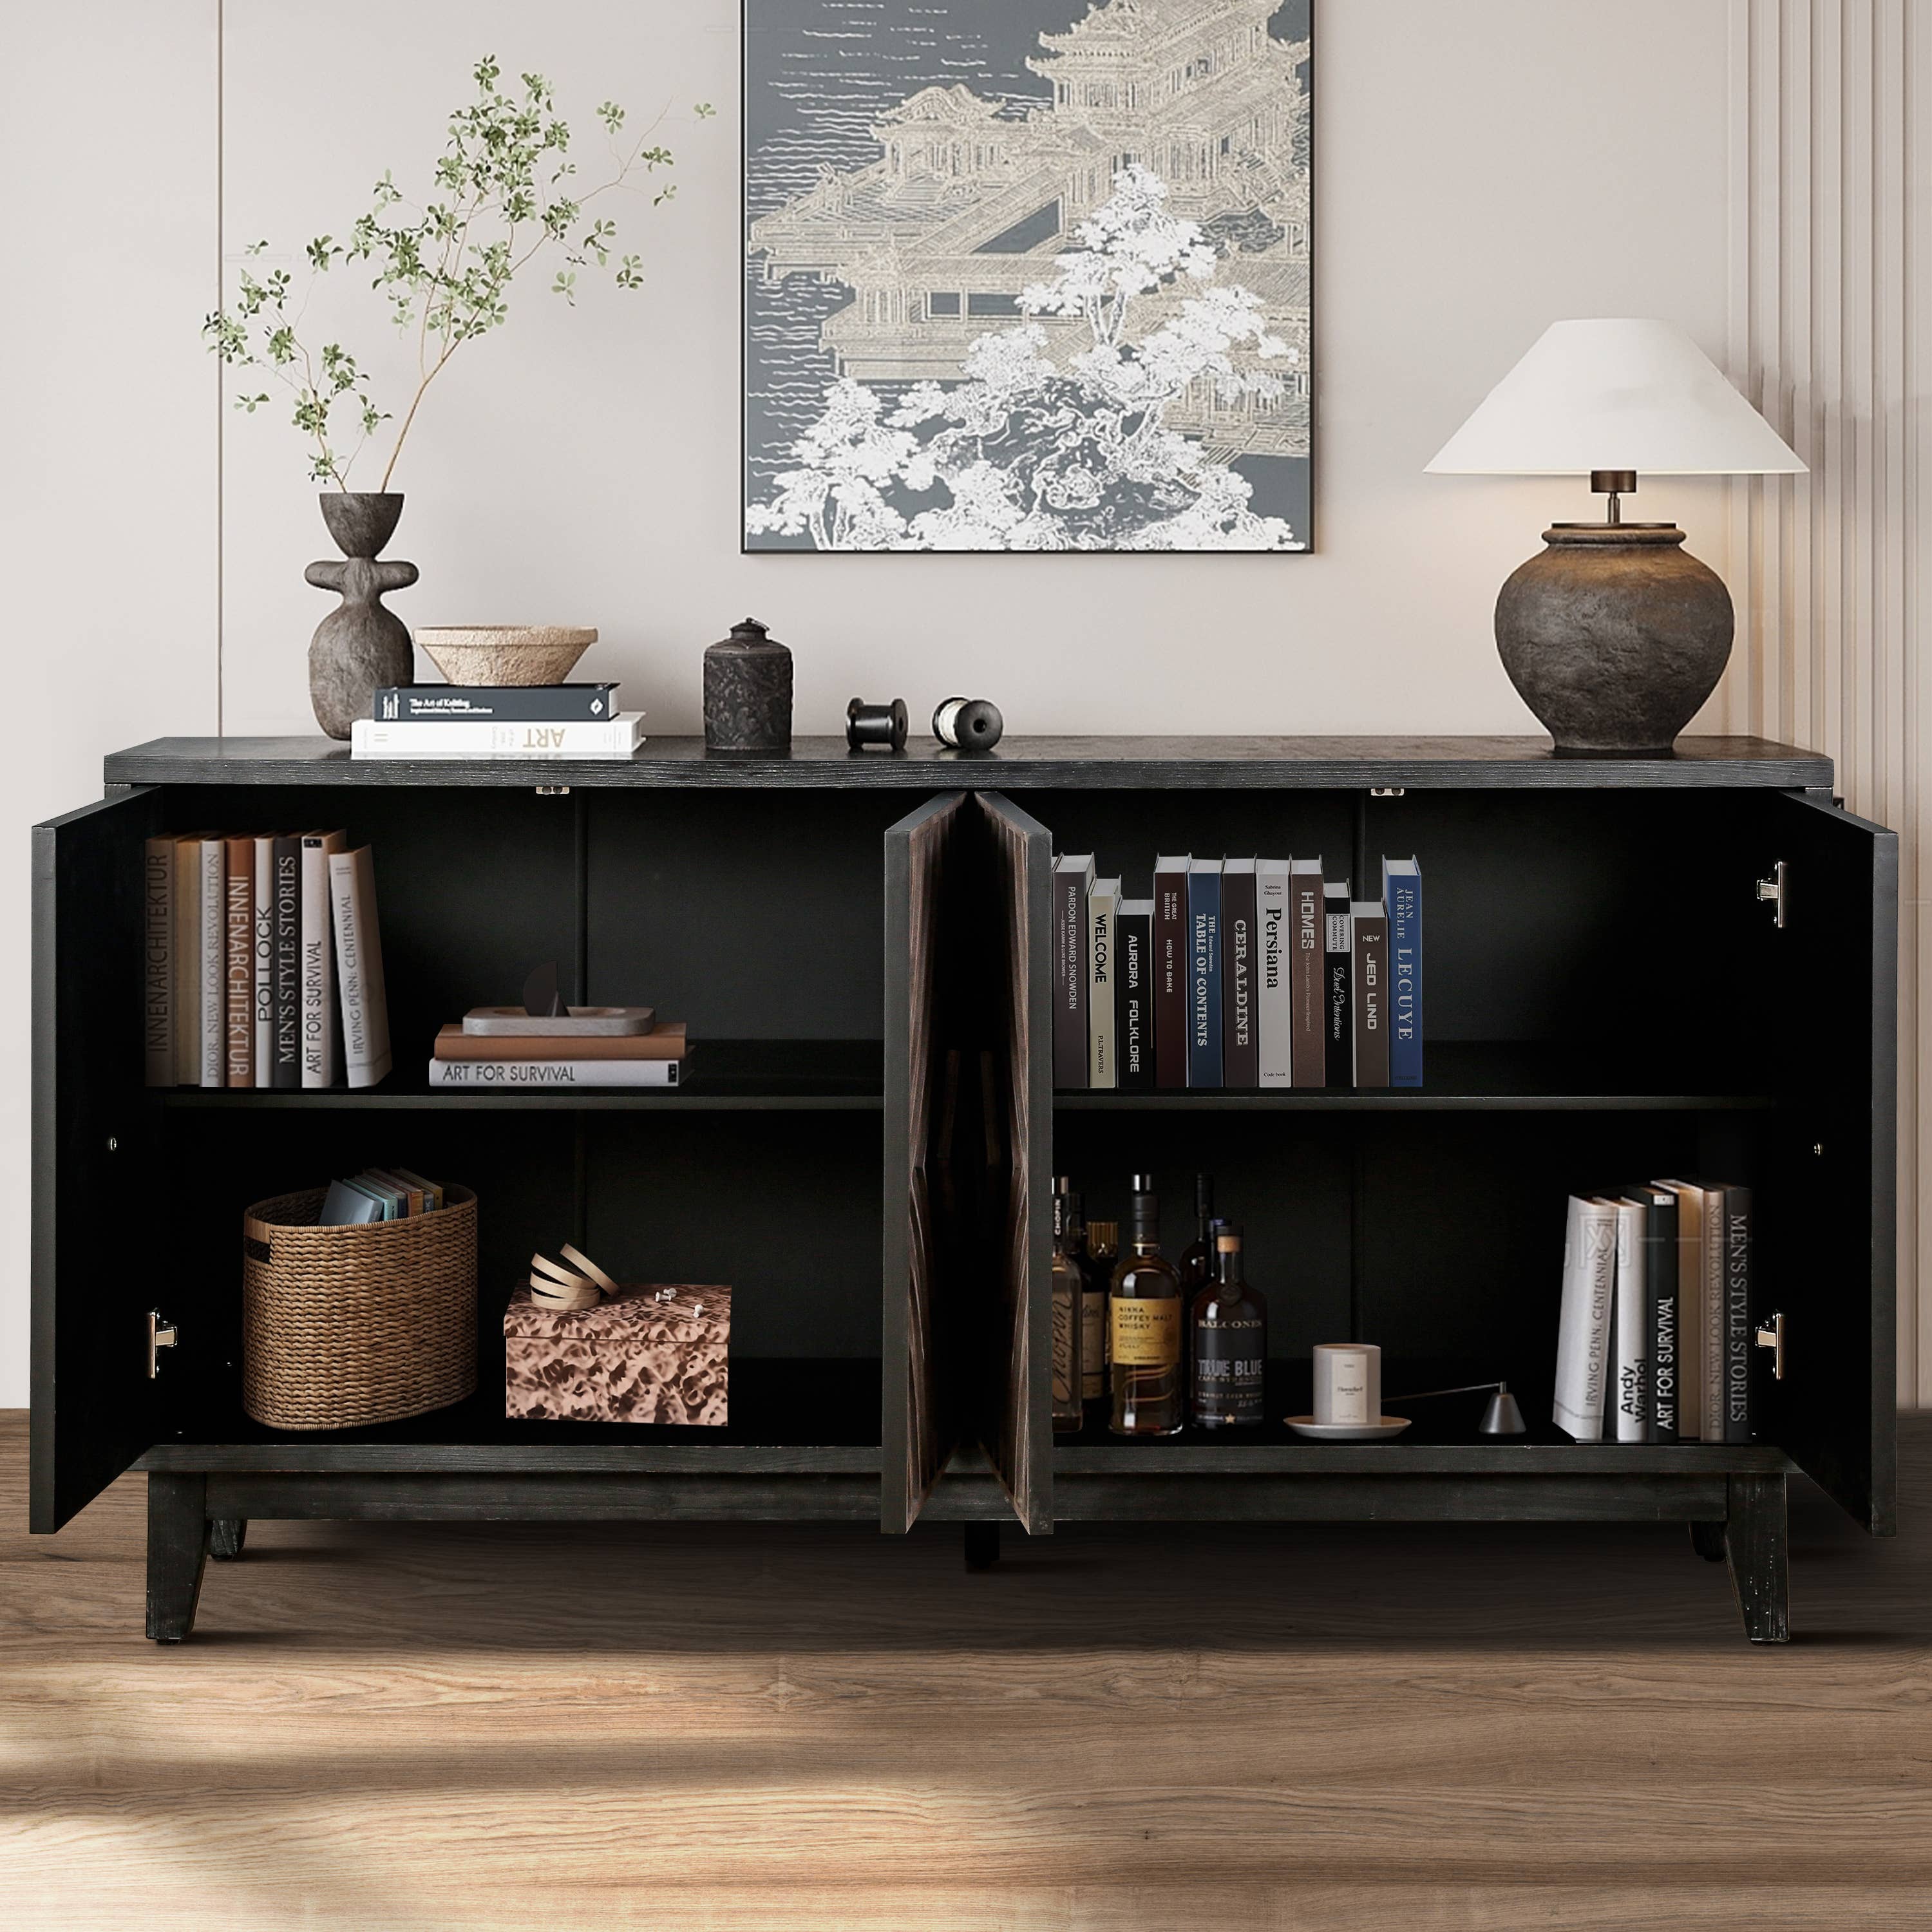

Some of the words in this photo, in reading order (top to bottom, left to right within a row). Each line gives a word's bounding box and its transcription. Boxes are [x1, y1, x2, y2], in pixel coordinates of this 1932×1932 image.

[523, 728, 565, 748] ART
[206, 853, 219, 951] REVOLUTION
[278, 857, 296, 936] STORIES
[1068, 886, 1076, 922] PARDON
[1405, 889, 1414, 919] JEAN
[341, 895, 357, 969] CENTENNIAL
[1196, 913, 1206, 953] TABLE
[1302, 891, 1314, 949] HOMES
[147, 854, 167, 1052] INNENARCHITEKTUR
[257, 907, 273, 1021] POLLOCK
[278, 941, 296, 1000] STYLE
[1095, 913, 1106, 983] WELCOME
[1128, 934, 1138, 989] AURORA
[1166, 960, 1172, 969] TO
[1197, 957, 1206, 974] OF
[1265, 907, 1282, 989] Persiana
[1367, 953, 1376, 986] JED
[206, 956, 219, 996] LOOK
[228, 876, 249, 1075] INNENARCHITEKTUR
[307, 941, 322, 1007] SURVIVAL
[1068, 964, 1077, 1009] SNOWDEN
[1333, 967, 1345, 994] Duel
[1397, 947, 1413, 1040] LECUYE
[206, 1000, 219, 1034] NEW
[307, 1009, 322, 1039] FOR
[350, 1009, 365, 1054] IRVING
[1197, 978, 1207, 1046] CONTENTS
[1367, 993, 1377, 1030] LIND
[1129, 1000, 1139, 1073] FOLKLORE
[307, 1048, 322, 1074] ART
[442, 1065, 470, 1081] ART
[476, 1065, 505, 1081] FOR
[510, 1065, 575, 1081] SURVIVAL
[1709, 1205, 1721, 1302] REVOLUTION
[1657, 1296, 1674, 1363] SURVIVAL
[1709, 1306, 1721, 1347] LOOK
[1730, 1277, 1747, 1337] STYLE
[1235, 1359, 1263, 1376] BLUE
[1586, 1363, 1600, 1407] IRVING
[1657, 1367, 1674, 1398] FOR
[1709, 1351, 1721, 1385] NEW
[1730, 1341, 1747, 1422] STORIES
[1620, 1366, 1636, 1415] Andy
[1634, 1359, 1647, 1423] Warhol
[1657, 1402, 1674, 1430] ART
